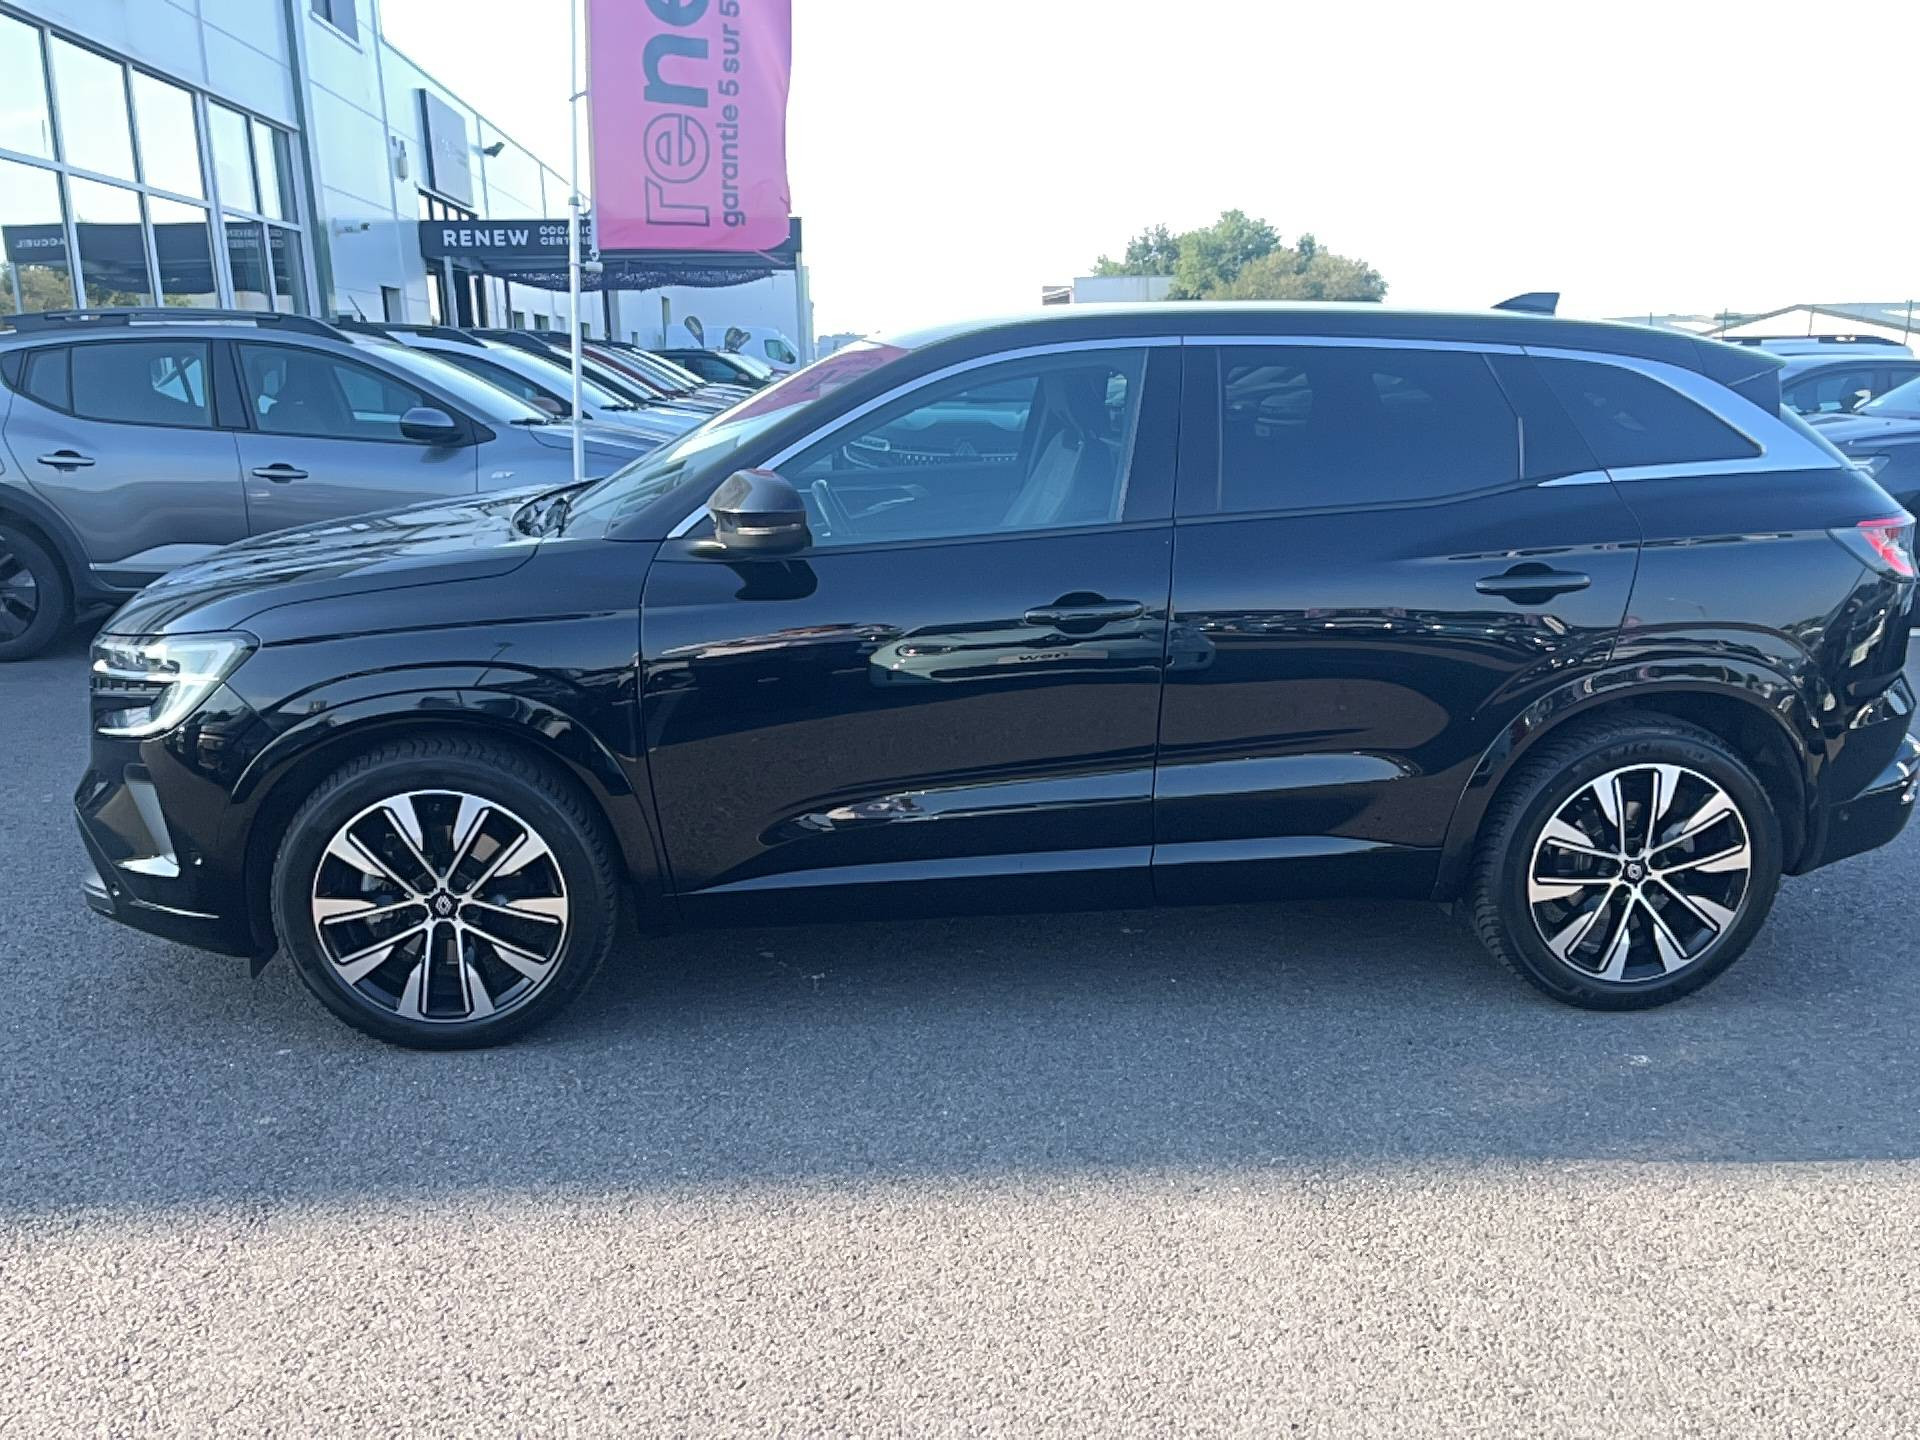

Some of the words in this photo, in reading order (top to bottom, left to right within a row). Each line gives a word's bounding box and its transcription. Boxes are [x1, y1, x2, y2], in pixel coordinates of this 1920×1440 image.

[719, 0, 740, 17] 5
[722, 23, 741, 74] sur
[718, 79, 740, 97] 5
[716, 104, 746, 228] garantie
[442, 229, 529, 247] RENEW
